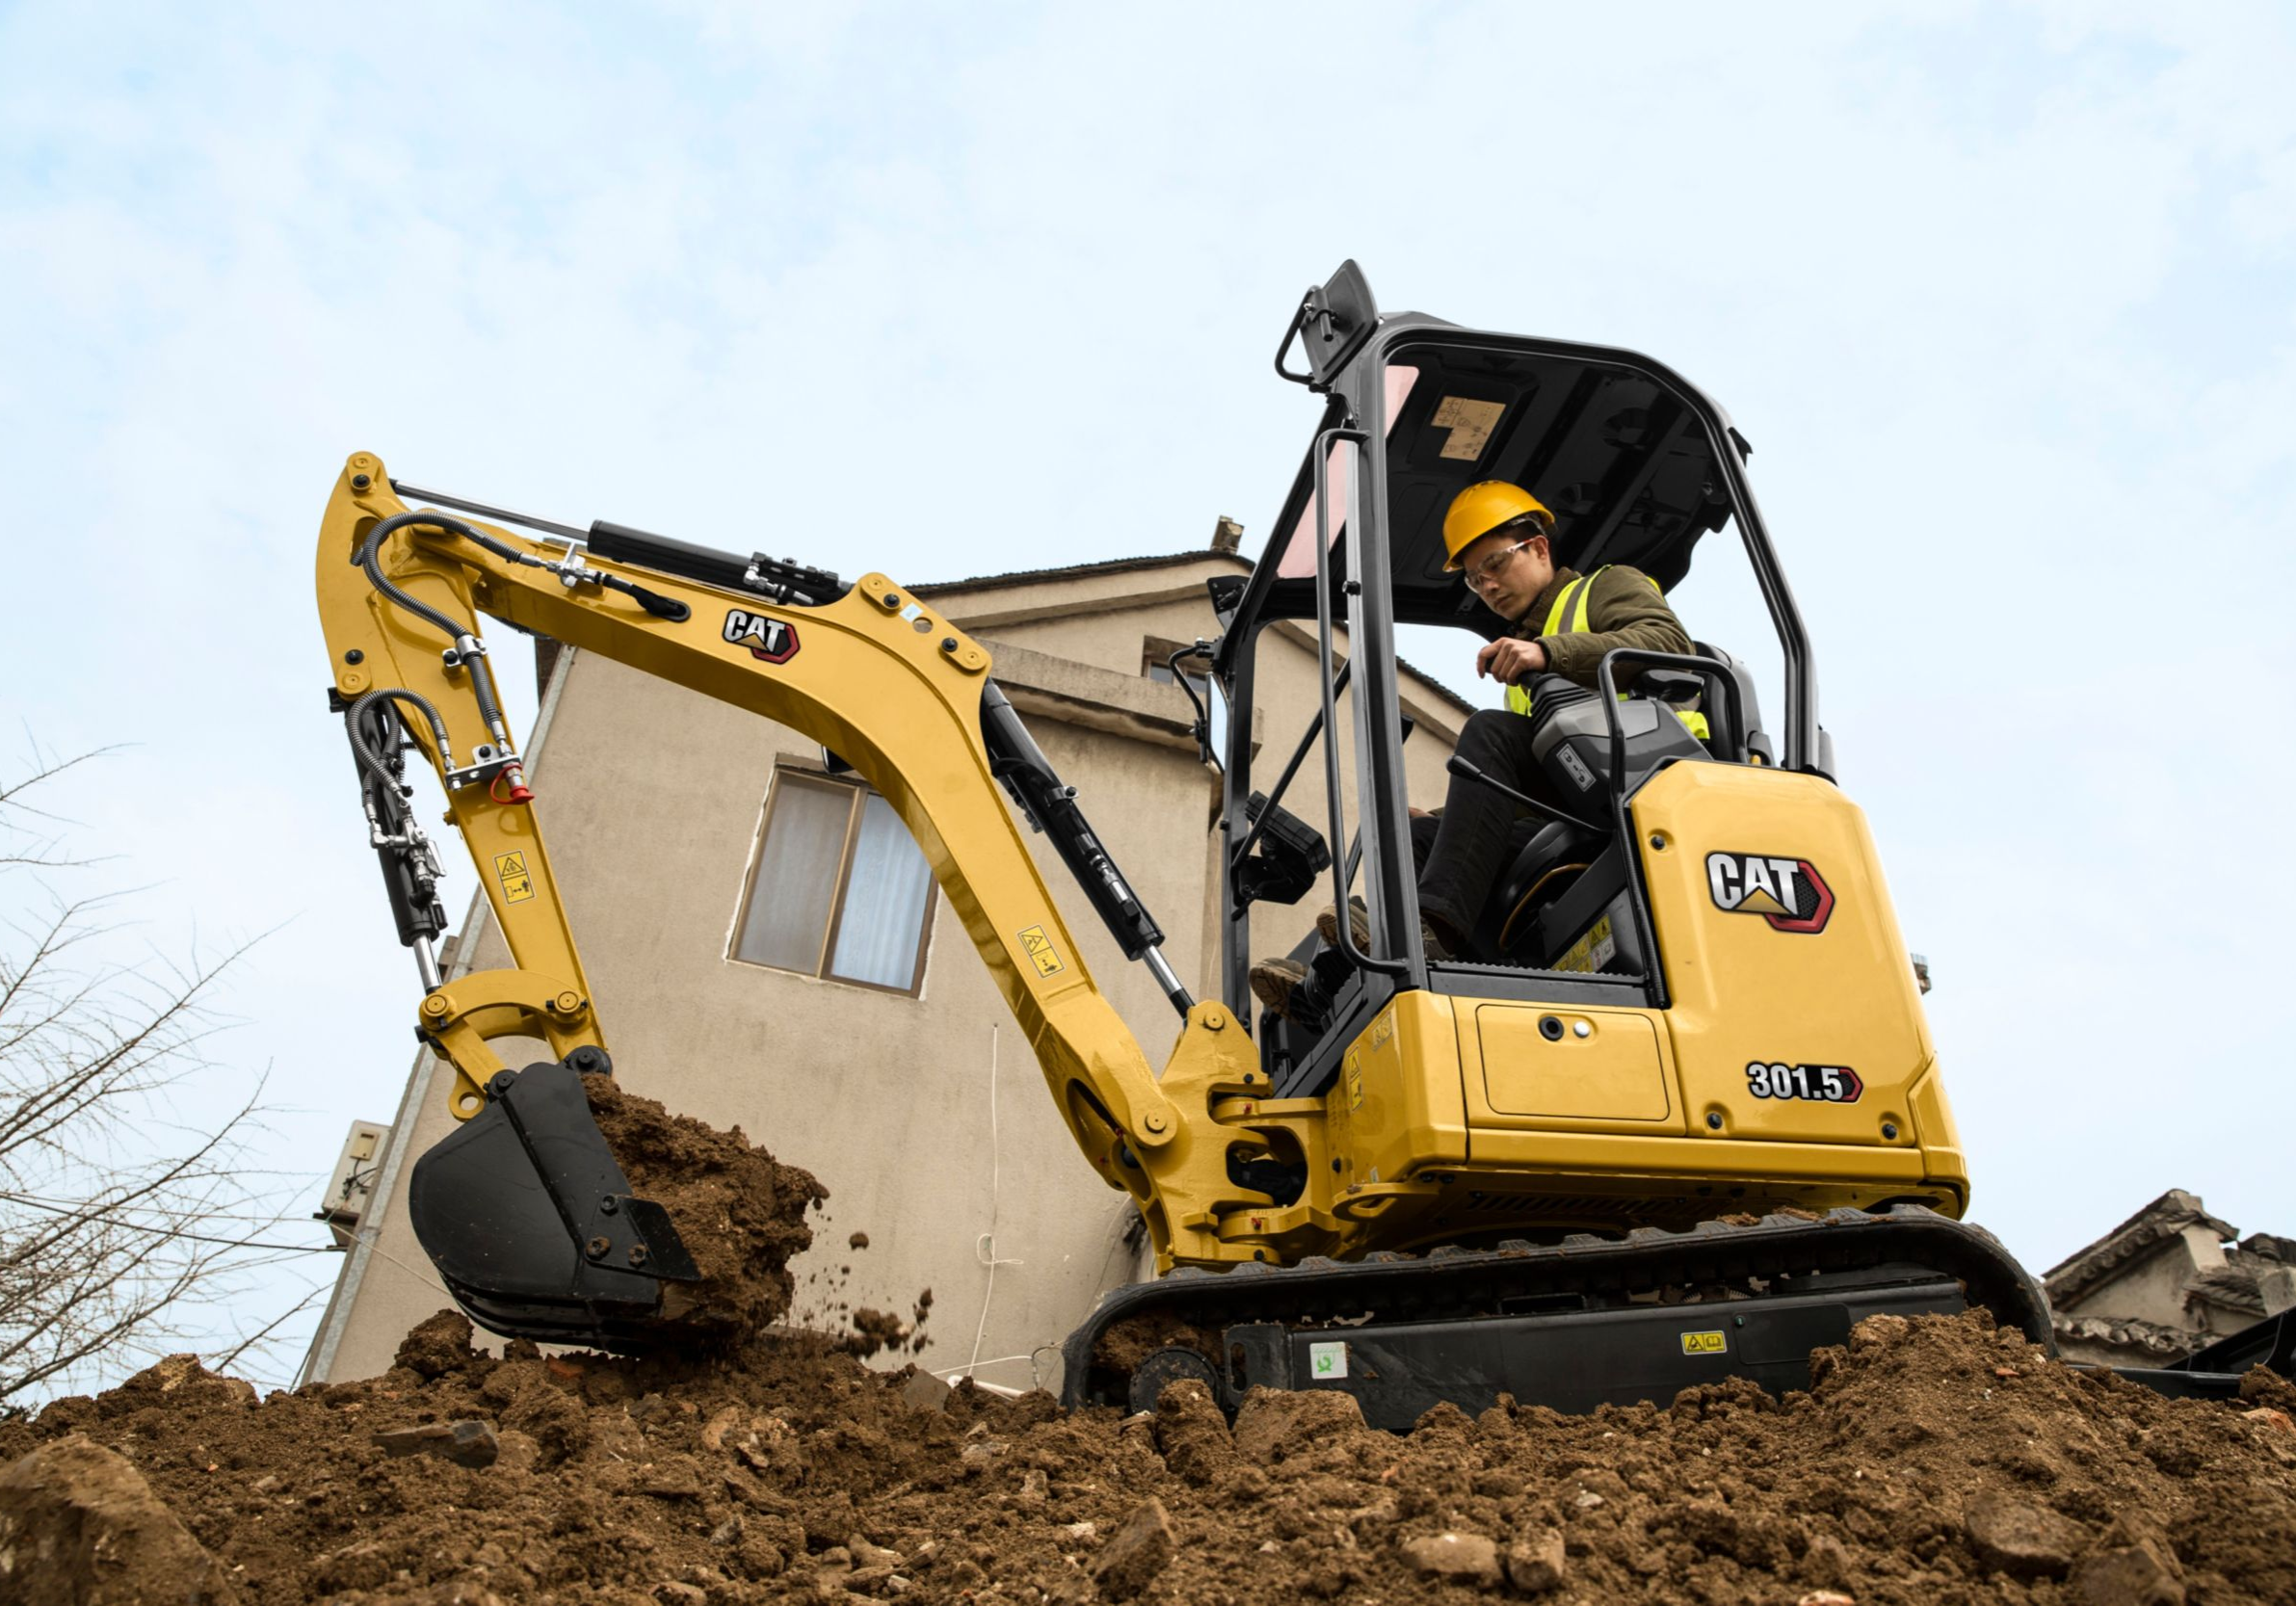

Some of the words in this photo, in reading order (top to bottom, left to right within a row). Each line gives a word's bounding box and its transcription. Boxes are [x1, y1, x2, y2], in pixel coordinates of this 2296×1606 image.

[724, 610, 786, 652] CAT
[1707, 853, 1800, 915] CAT
[1748, 1064, 1843, 1100] 301.5
